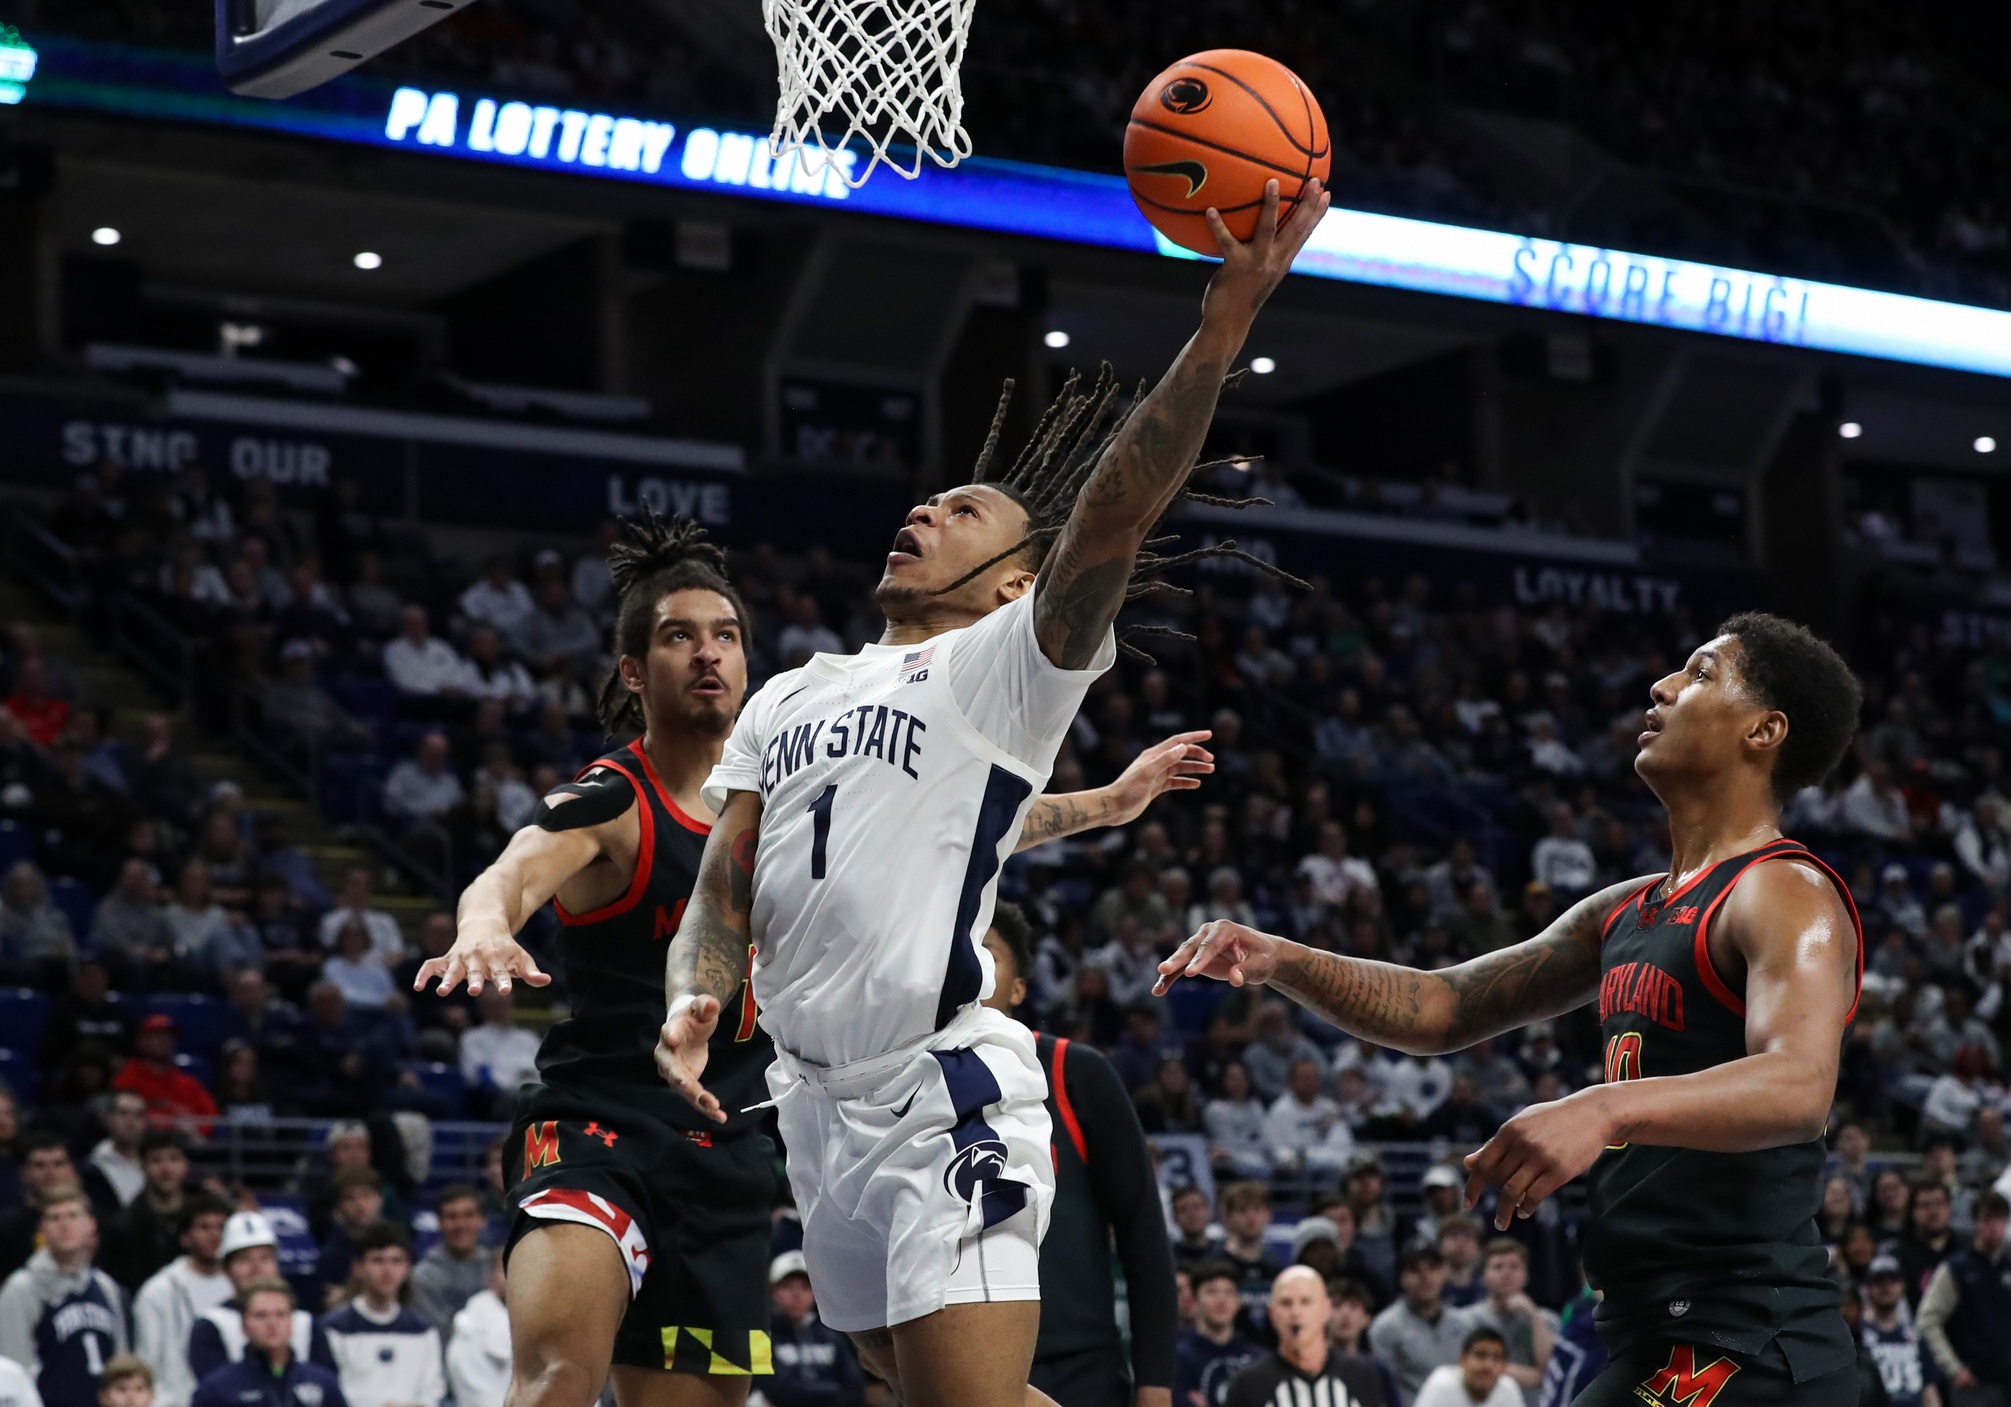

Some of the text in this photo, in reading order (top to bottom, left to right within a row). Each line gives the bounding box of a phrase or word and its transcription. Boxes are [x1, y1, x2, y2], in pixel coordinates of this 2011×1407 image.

[384, 87, 859, 199] PA LOTTERY ONLINE
[1509, 247, 1680, 326] SCORE
[230, 437, 331, 487] OUR
[607, 473, 729, 524] LOVE
[1513, 564, 1682, 614] LOYALTY
[827, 705, 926, 781] STATE
[806, 784, 838, 879] 1
[1599, 962, 1685, 1032] ARYLAND
[522, 1119, 562, 1182] M
